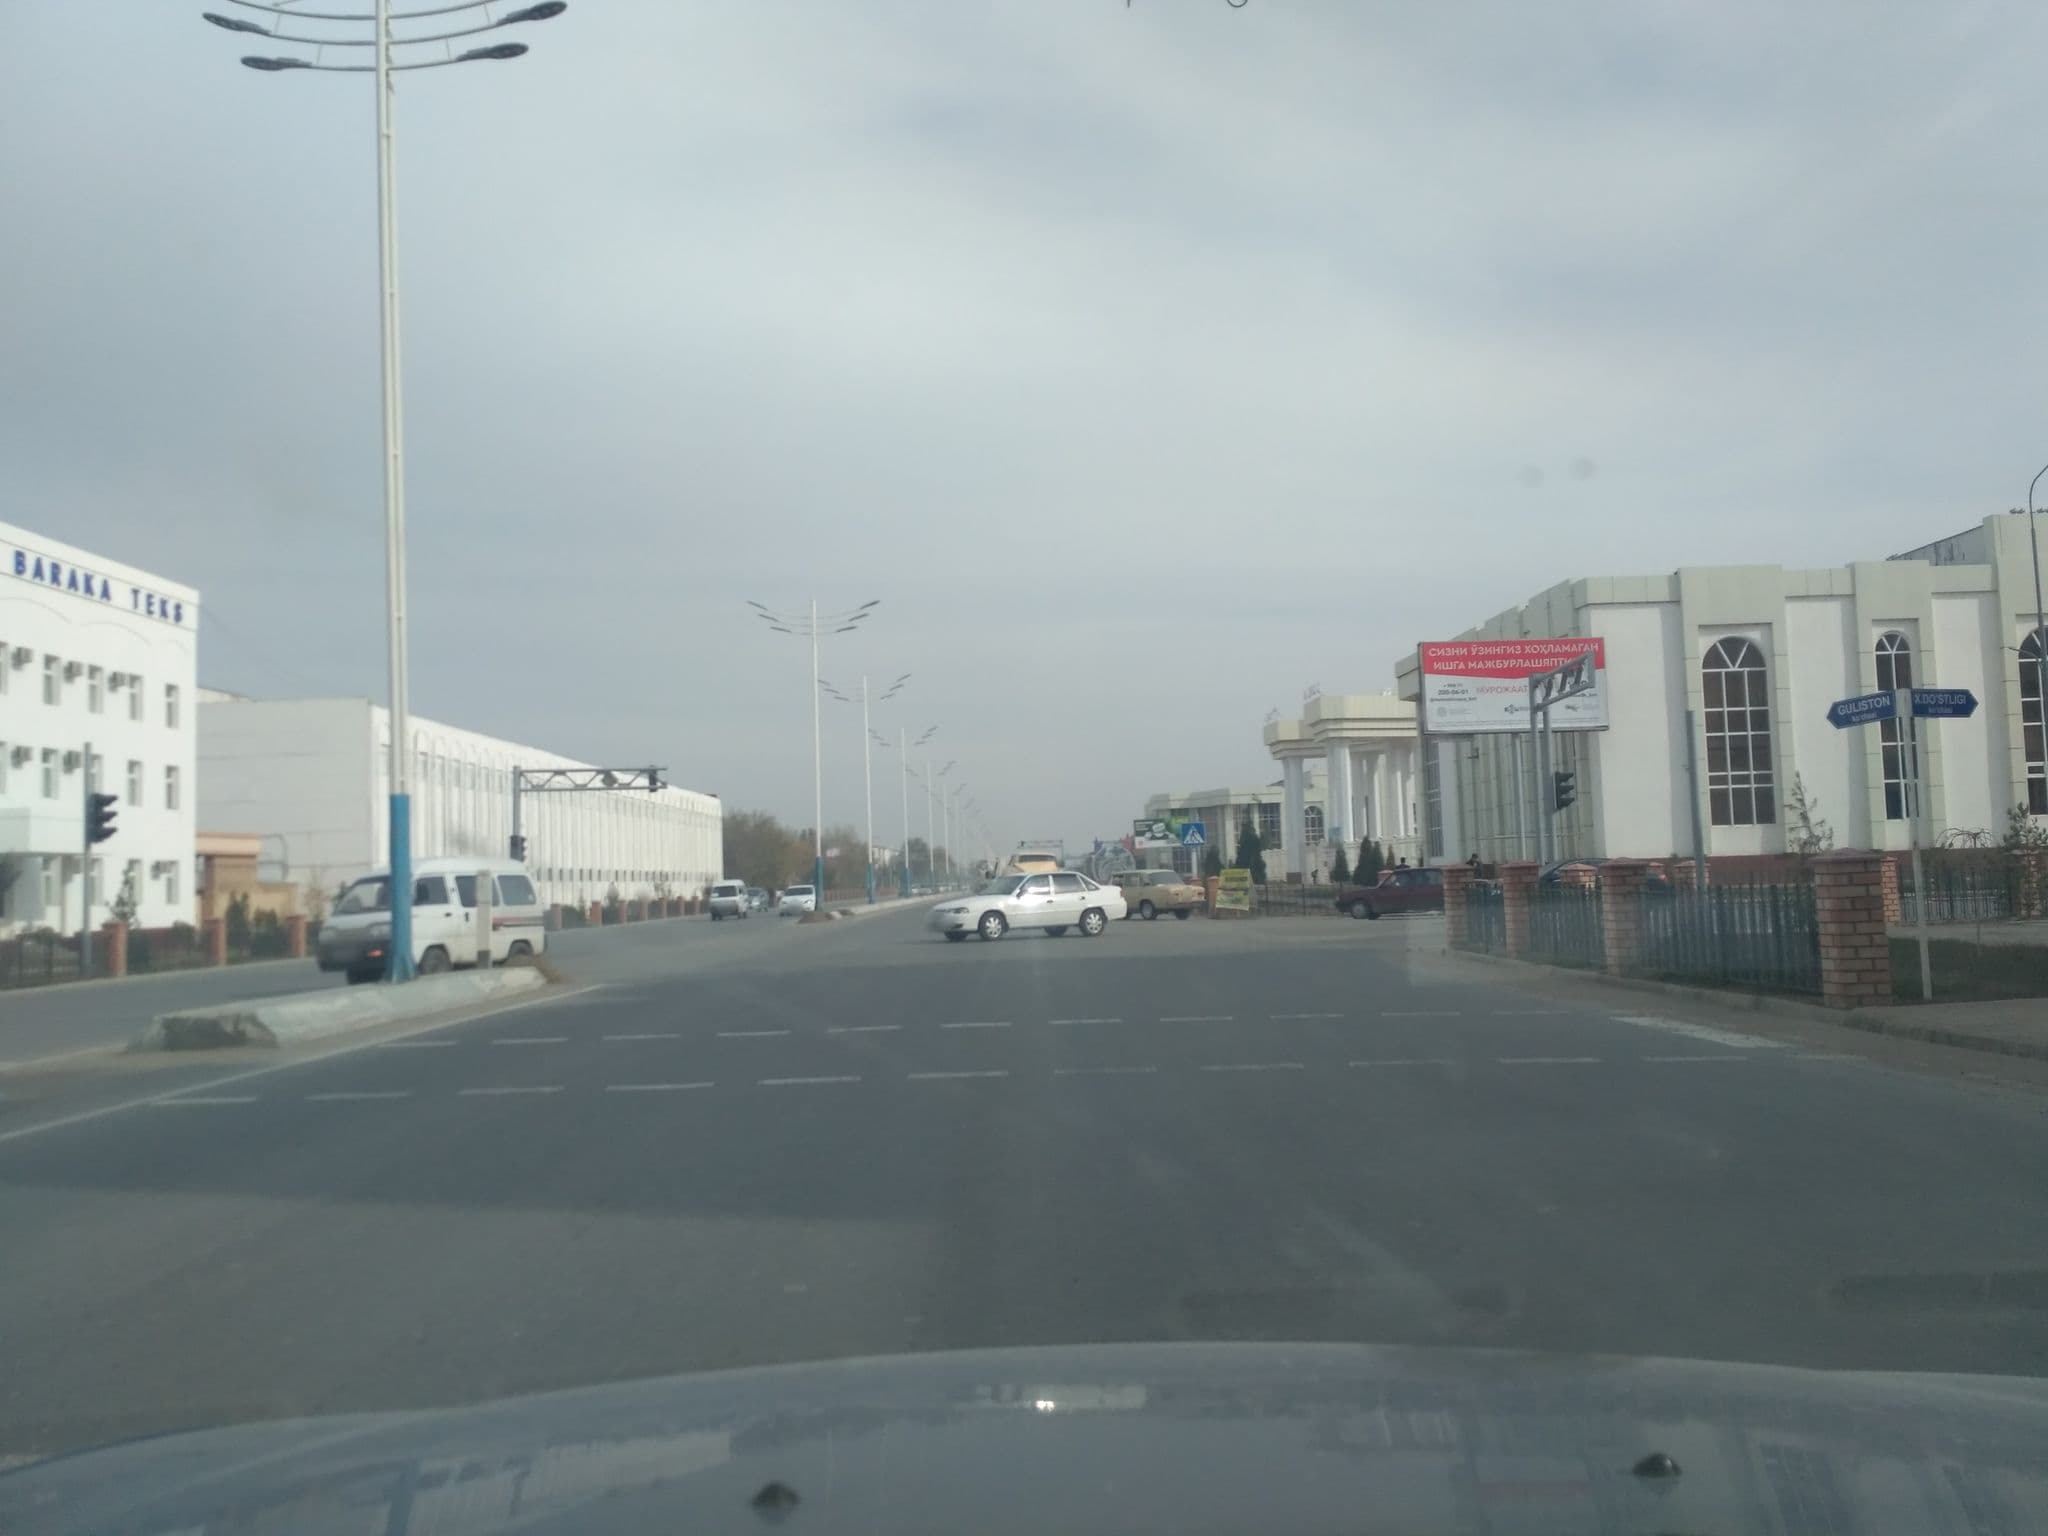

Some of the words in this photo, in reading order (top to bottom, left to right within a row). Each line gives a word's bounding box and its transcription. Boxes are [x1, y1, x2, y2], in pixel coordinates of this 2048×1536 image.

[14, 550, 112, 601] BARAKA
[131, 588, 183, 623] TEKS
[1429, 645, 1468, 657] СИЗНИ
[1471, 642, 1521, 656] ЎЗИНГИЗ
[1524, 642, 1599, 656] ХОҲЛАМАГАН
[1433, 659, 1464, 671] ИШГА
[1838, 695, 1890, 716] GULISTON
[1914, 694, 1967, 705] X.DO'STLIGI
